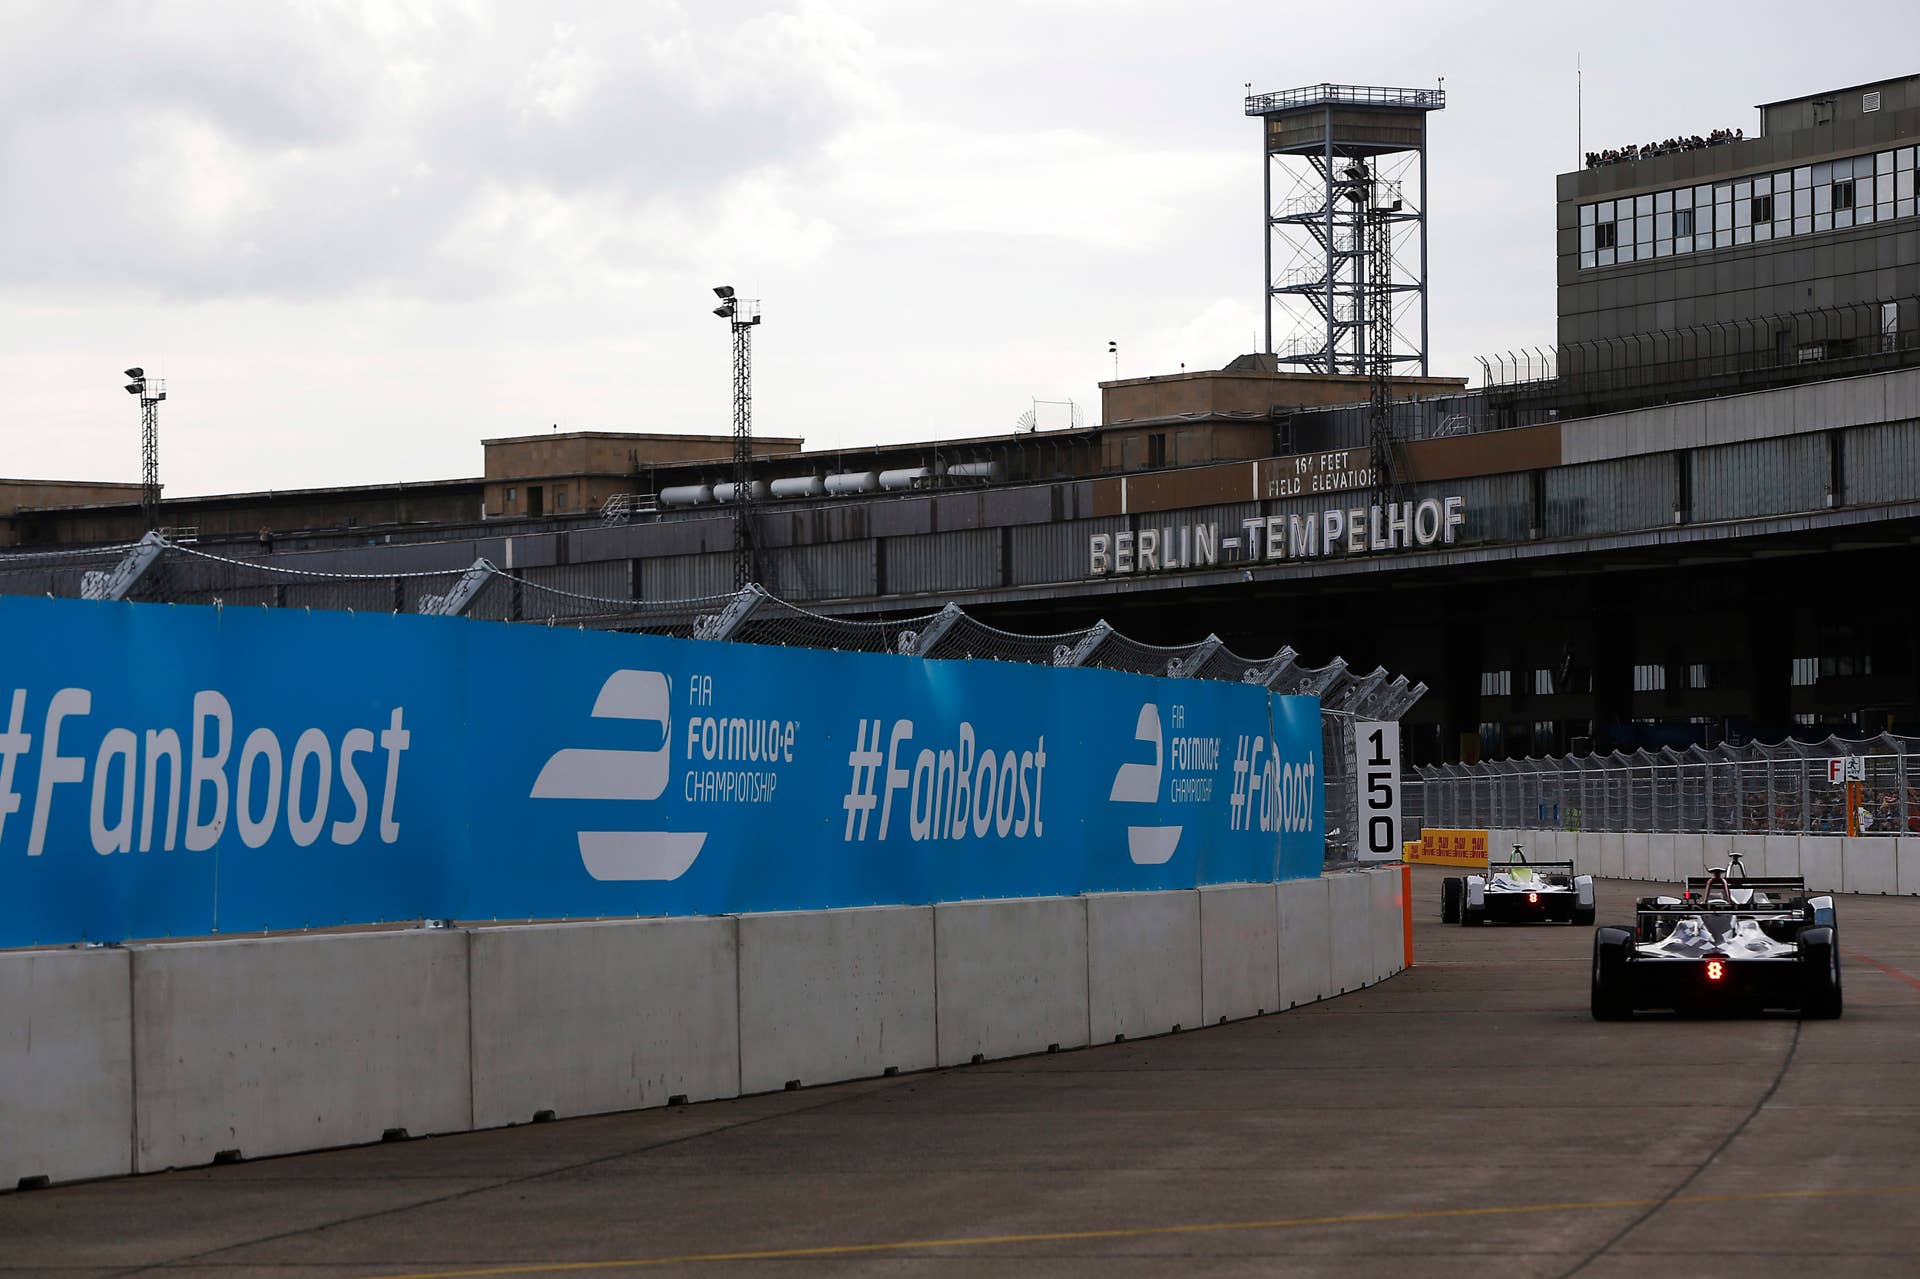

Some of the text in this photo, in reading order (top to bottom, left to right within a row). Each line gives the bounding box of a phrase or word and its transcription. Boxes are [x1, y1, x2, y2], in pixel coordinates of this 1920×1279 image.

[1321, 452, 1349, 472] FEET
[1268, 477, 1301, 497] FIELD
[689, 675, 712, 706] FIA
[1172, 704, 1185, 729] FIA
[843, 718, 1046, 842] #FanBoost
[1830, 760, 1842, 781] F
[685, 770, 777, 803] CHAMPIONSHIP
